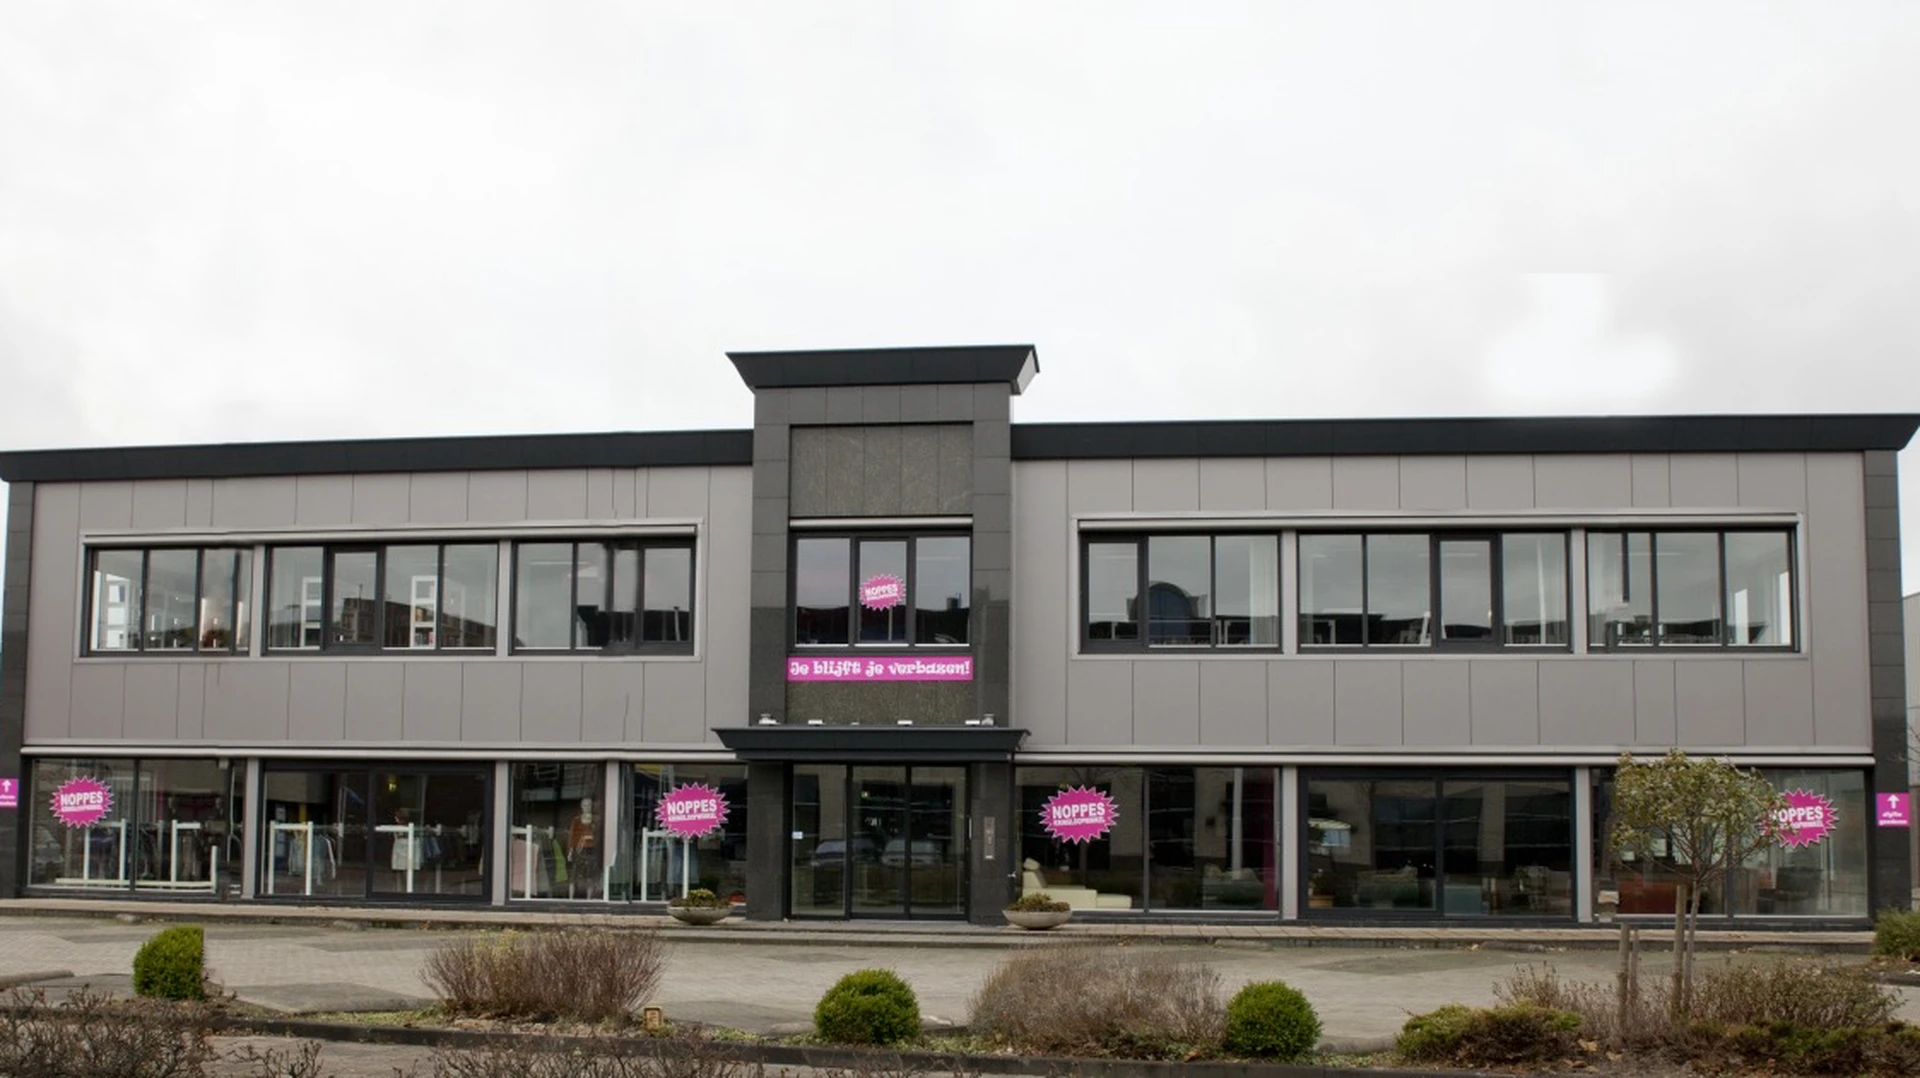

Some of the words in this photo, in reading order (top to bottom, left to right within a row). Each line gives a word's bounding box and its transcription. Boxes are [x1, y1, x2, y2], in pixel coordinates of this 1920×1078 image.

[865, 583, 899, 597] NOPPES
[789, 661, 809, 676] Je
[813, 661, 861, 677] blijft
[865, 661, 884, 677] je
[888, 661, 970, 675] verbazen!
[60, 791, 103, 806] NOPPES
[667, 799, 717, 815] NOPPES
[1052, 802, 1105, 819] NOPPES
